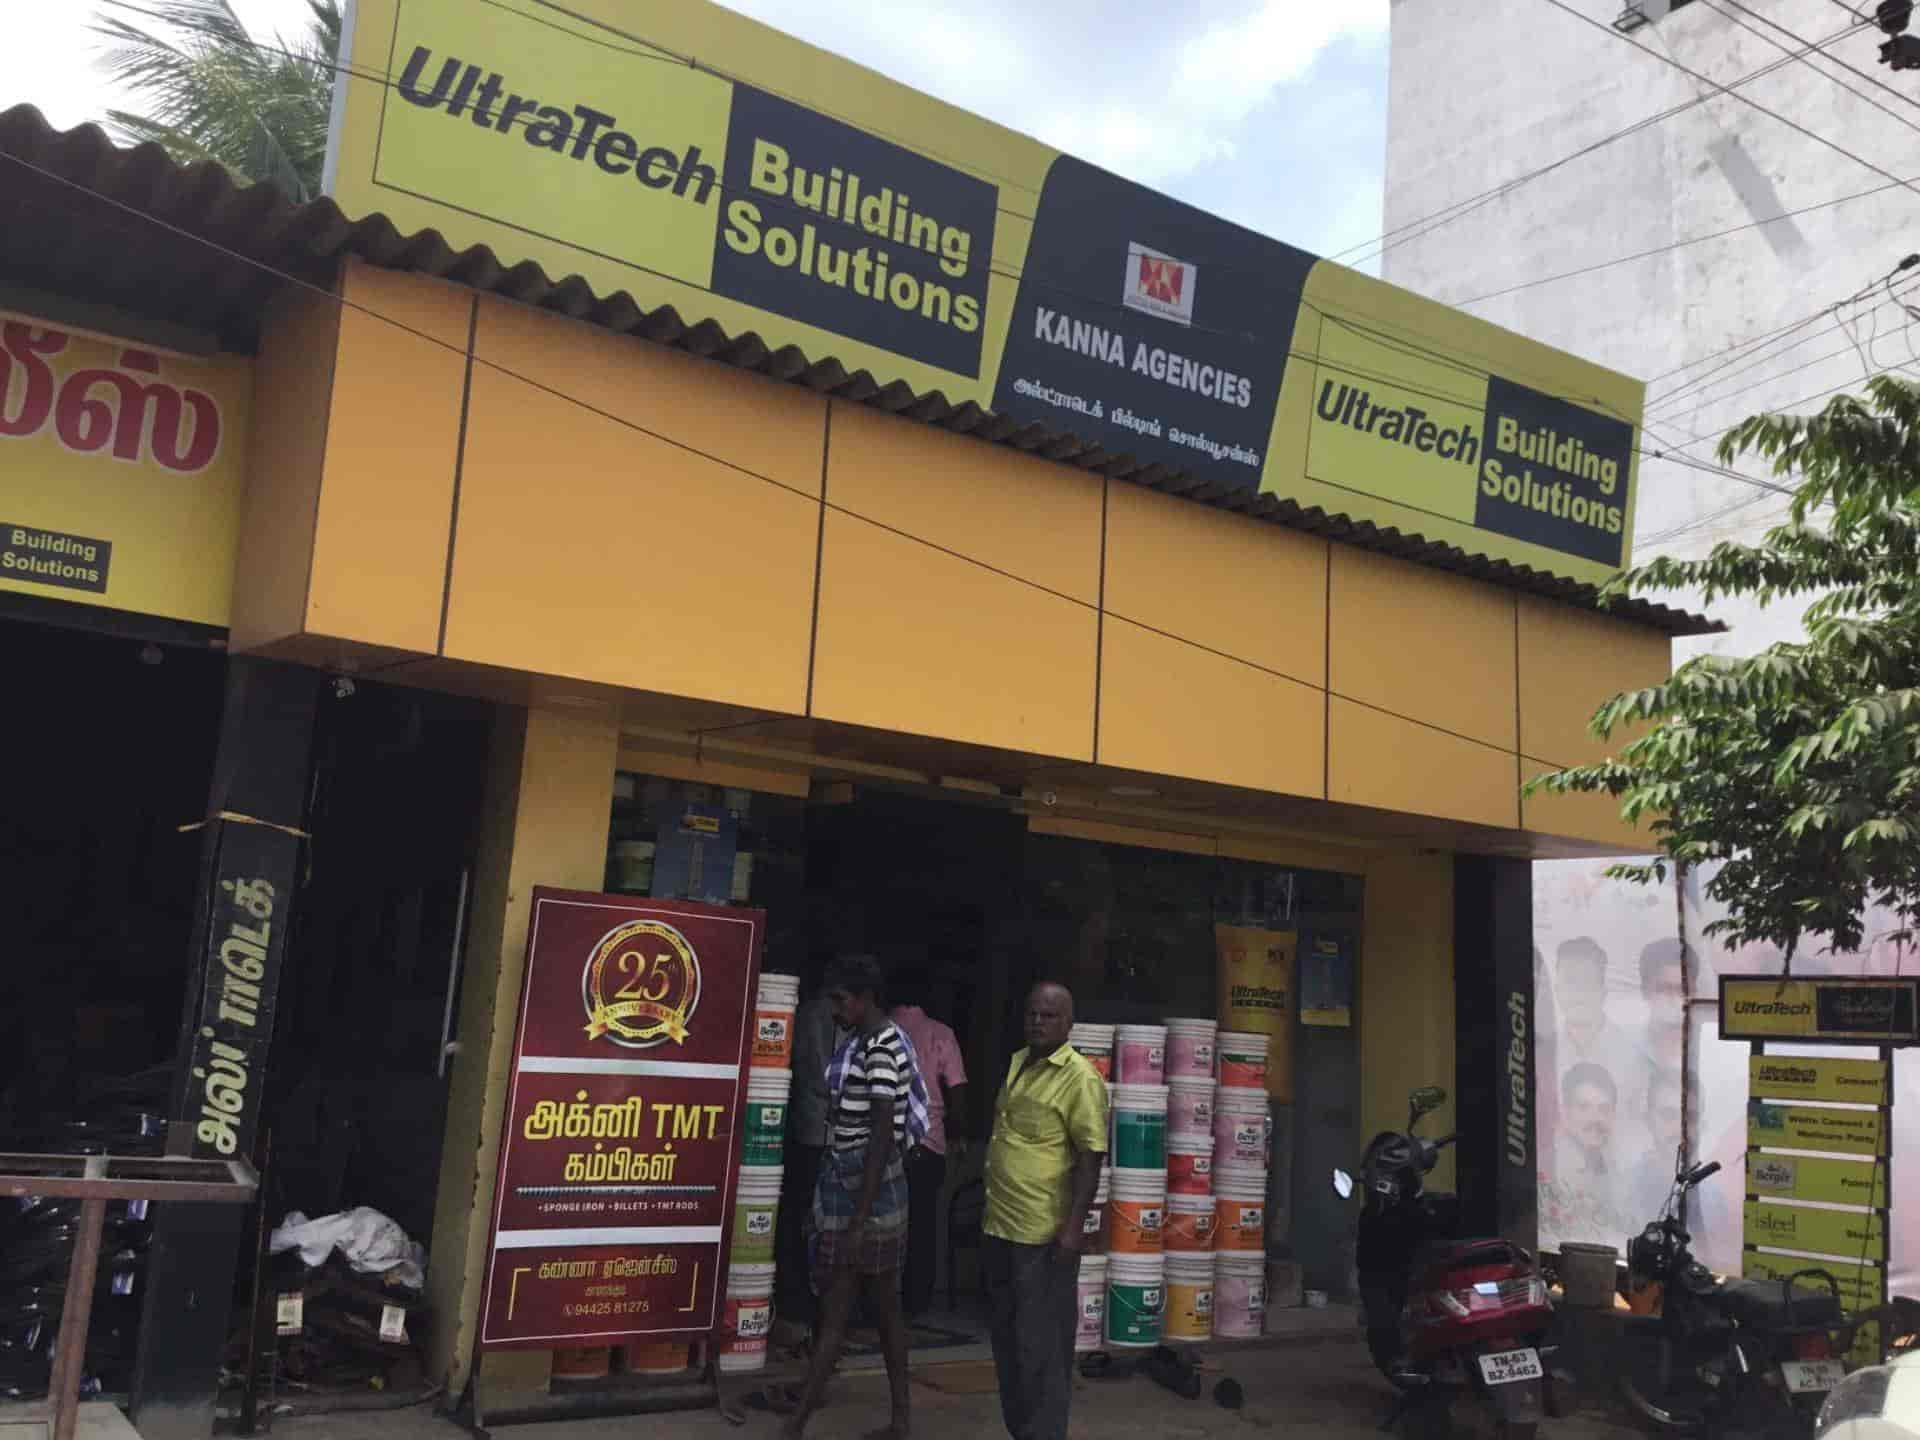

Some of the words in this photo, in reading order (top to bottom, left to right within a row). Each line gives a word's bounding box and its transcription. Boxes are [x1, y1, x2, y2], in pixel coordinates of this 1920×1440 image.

[397, 45, 717, 206] UltraTech
[749, 137, 971, 276] Building
[724, 199, 981, 332] Solutions
[1034, 306, 1126, 368] KANNA
[1131, 343, 1252, 409] AGENCIES
[1316, 379, 1479, 467] UltraTech
[1496, 416, 1618, 496] Building
[1481, 458, 1622, 534] Solutions
[2, 551, 100, 583] Solutions
[11, 529, 97, 562] Building
[1733, 1001, 1811, 1016] UltraTech
[523, 1088, 643, 1140] அக்னி
[651, 1103, 725, 1140] TMT
[1507, 991, 1527, 1167] UltraTech
[563, 1142, 678, 1182] கம்பிகள்
[543, 1203, 580, 1212] SPONGE
[582, 1202, 605, 1211] IRON
[614, 1201, 649, 1211] BILLETS
[657, 1201, 674, 1210] TMT
